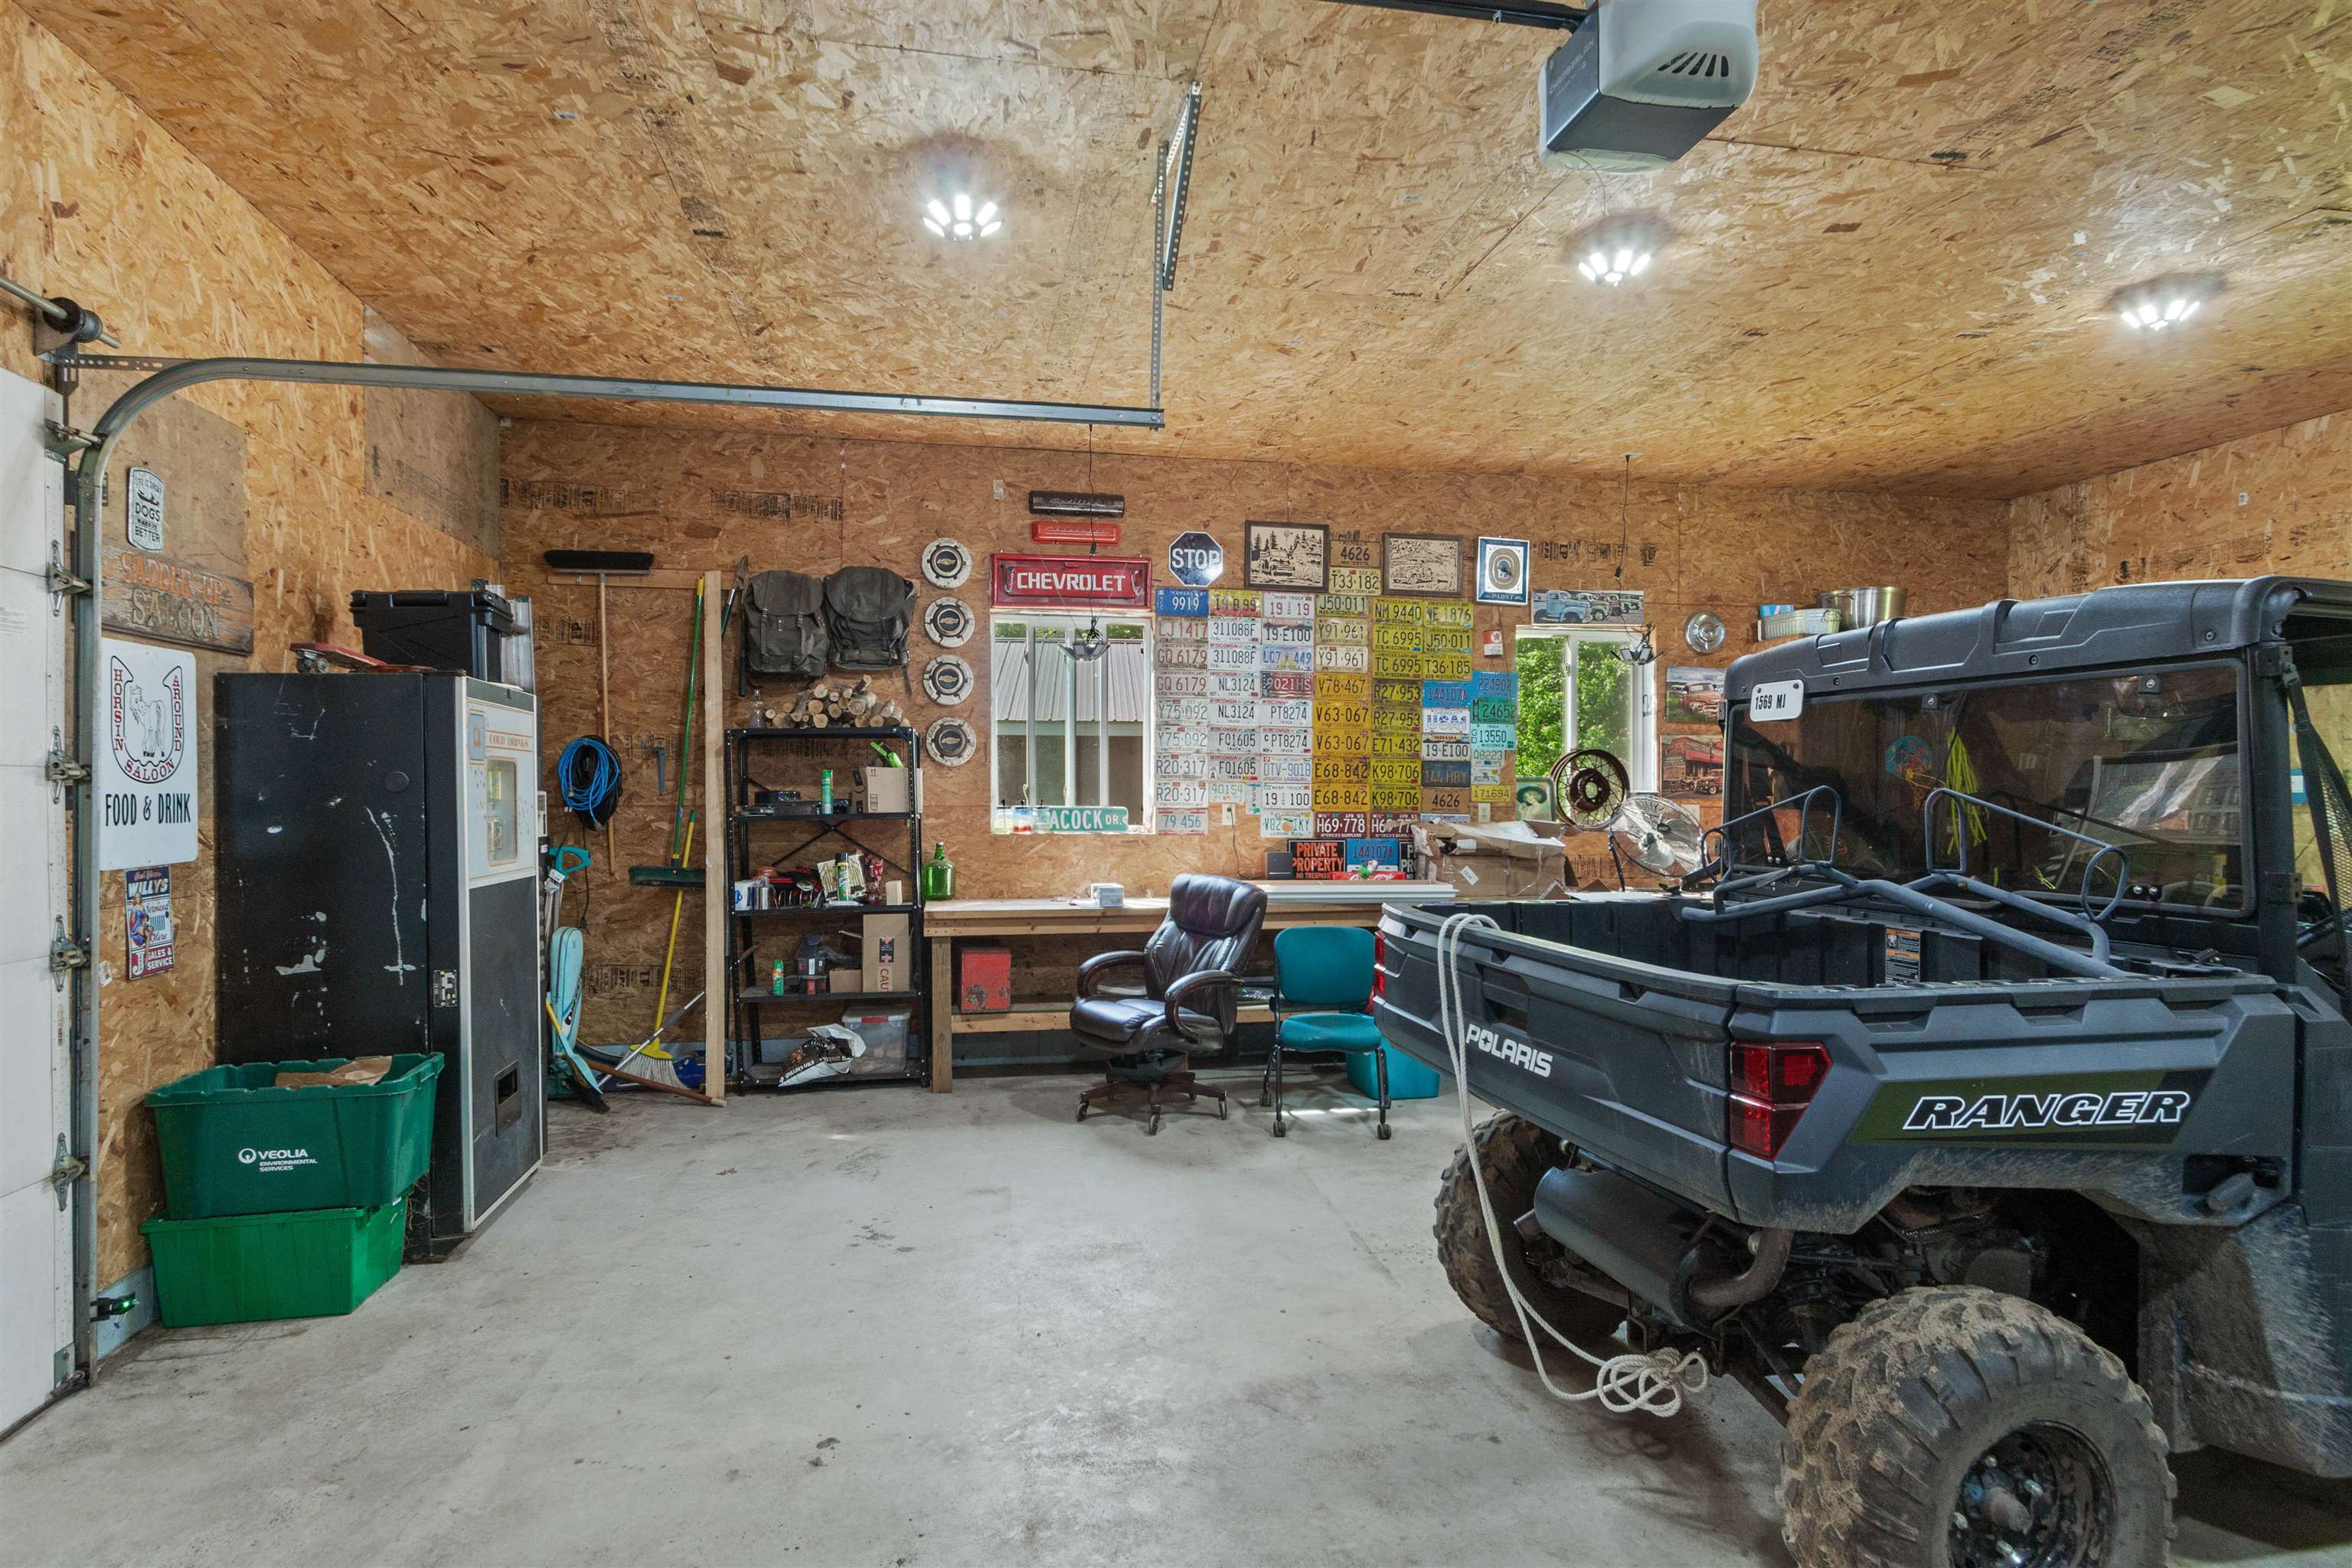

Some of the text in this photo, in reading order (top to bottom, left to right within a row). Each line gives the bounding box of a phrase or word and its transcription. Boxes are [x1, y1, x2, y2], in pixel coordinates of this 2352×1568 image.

[135, 501, 160, 521] DOGS
[135, 525, 160, 542] BETTER
[1171, 548, 1220, 569] STOP
[1341, 547, 1370, 561] 4626
[121, 552, 224, 606] SADDLE UP
[1016, 572, 1125, 592] CHEVROLET
[1172, 597, 1200, 611] 9919
[1270, 602, 1310, 616] 19 19
[132, 588, 218, 639] SALOON
[1375, 604, 1422, 620] NM 9440
[1158, 622, 1208, 638] LJ 1417
[1214, 622, 1256, 636] 311088F
[1376, 630, 1421, 646] TC 6995
[1158, 649, 1207, 664] GQ 6179
[1214, 649, 1256, 664] 311088F
[1294, 652, 1312, 665] 449
[1375, 657, 1421, 673] TC 6995
[1157, 677, 1207, 691] GQ 6179
[1219, 678, 1255, 691] NL3124
[1756, 694, 1772, 710] 1569
[113, 669, 124, 751] HORSIN
[172, 675, 182, 751] AROUND
[1219, 704, 1255, 718] NL3124
[1271, 706, 1307, 720] PT8274
[1483, 704, 1517, 718] 24652
[488, 737, 529, 747] COLD DRINKS
[1219, 733, 1256, 747] FQ1605
[1272, 735, 1307, 747] PT8274
[1479, 730, 1507, 743] 13550
[124, 759, 175, 781] SALOON
[1219, 761, 1256, 775] FQ1605
[1266, 793, 1277, 805] 19
[1291, 793, 1310, 805] 100
[1432, 793, 1460, 808] 4626
[1473, 789, 1510, 798] 171694
[105, 793, 191, 827] FOOD & DRINK
[1050, 809, 1103, 829] ACOCK
[1163, 815, 1200, 828] 79 456
[1297, 842, 1338, 858] PRIVATE
[1292, 858, 1344, 871] PROPERTY
[128, 878, 168, 898] WILLYS
[150, 933, 167, 943] Here
[147, 949, 166, 959] SALES
[132, 951, 145, 976] J
[147, 959, 173, 971] SERVICE
[1465, 1023, 1553, 1078] POLARIS
[1903, 1090, 2190, 1130] RANGER
[257, 1148, 309, 1160] VEOLIA
